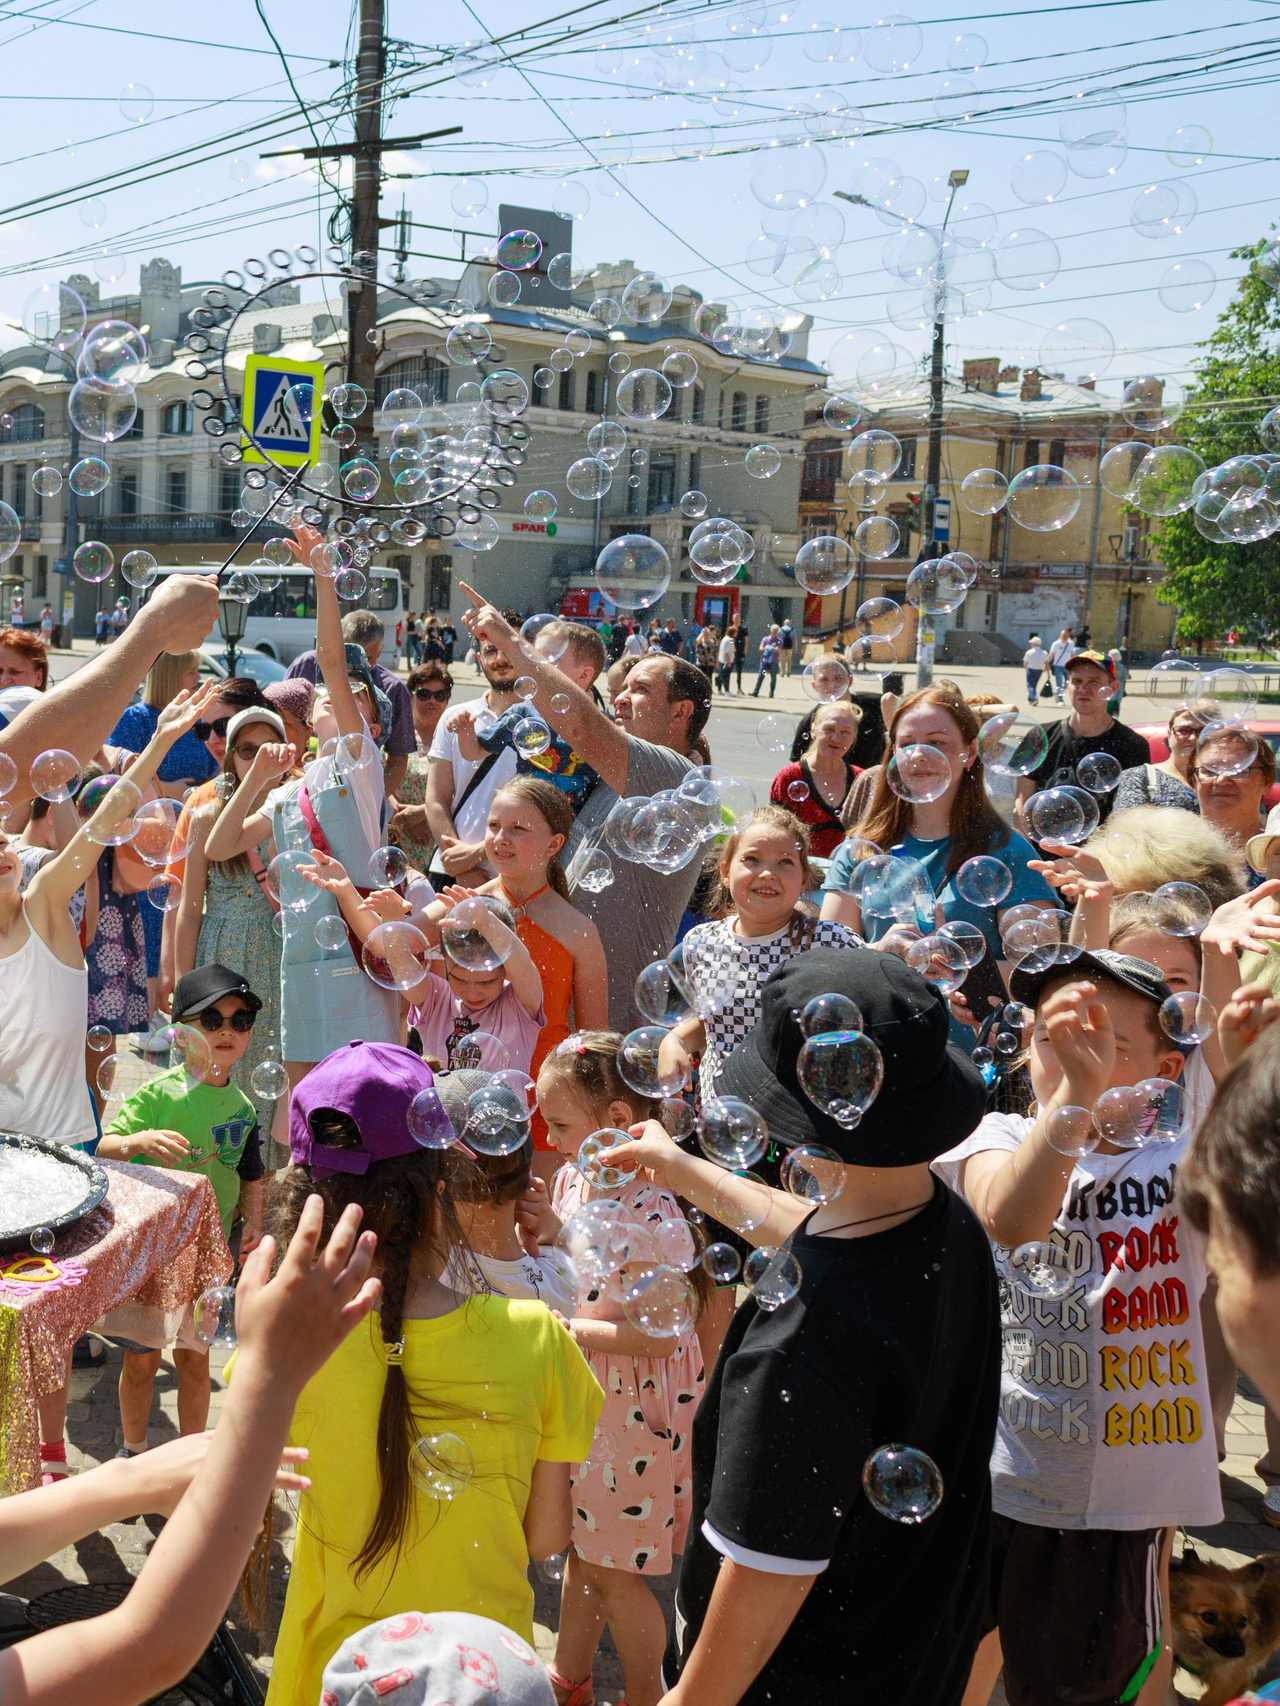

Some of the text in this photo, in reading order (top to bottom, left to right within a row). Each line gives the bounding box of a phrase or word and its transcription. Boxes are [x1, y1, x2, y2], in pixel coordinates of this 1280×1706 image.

[512, 522, 546, 533] SPAR
[1096, 1216, 1181, 1276] ROCK
[1100, 1277, 1190, 1335] BAND
[1012, 1332, 1027, 1345] YOU
[1098, 1339, 1197, 1392] ROCK
[1002, 1389, 1204, 1447] OCK BAND
